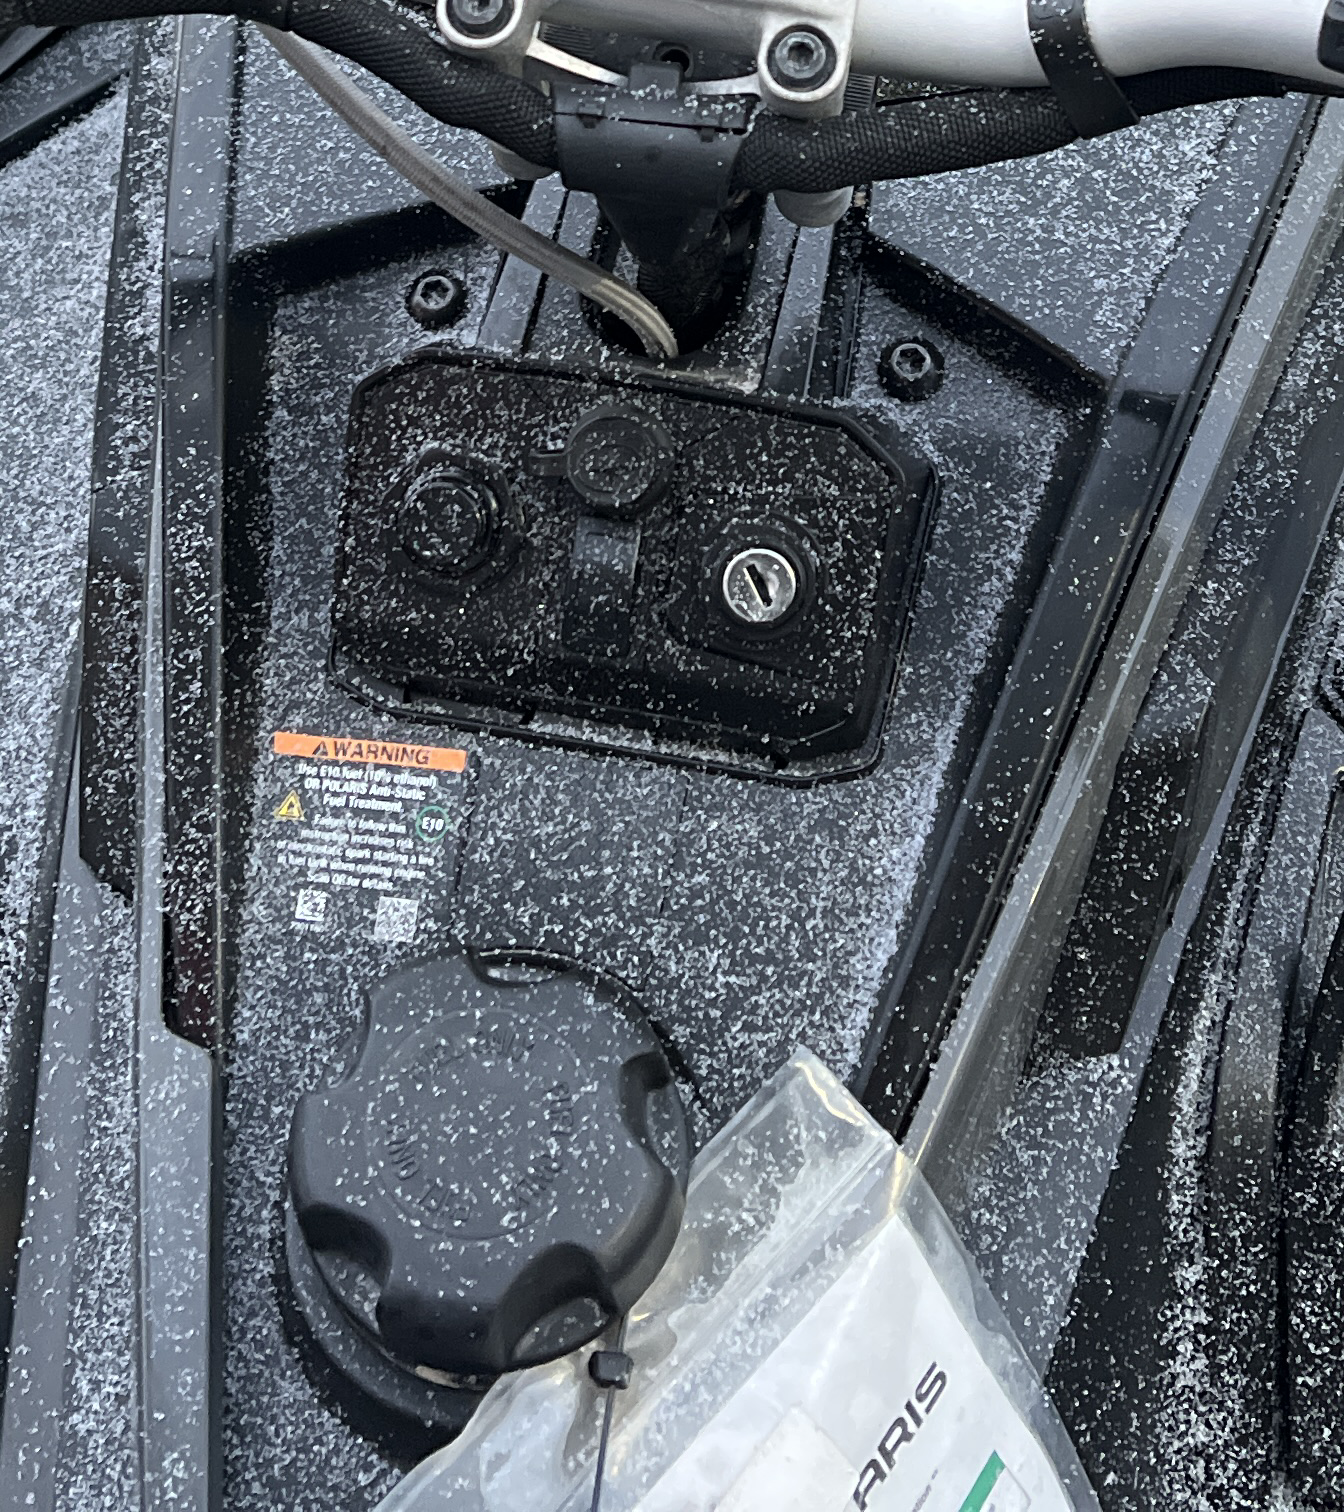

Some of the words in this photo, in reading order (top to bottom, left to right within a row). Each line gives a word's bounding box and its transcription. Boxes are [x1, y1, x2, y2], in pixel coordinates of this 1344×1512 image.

[333, 739, 430, 766] WARNING
[304, 777, 320, 789] OR
[321, 778, 367, 795] POLARIS
[369, 783, 426, 801] Anti-Static
[322, 792, 345, 806] Fuel
[421, 816, 444, 833] E10
[852, 1360, 948, 1512] ARIS
